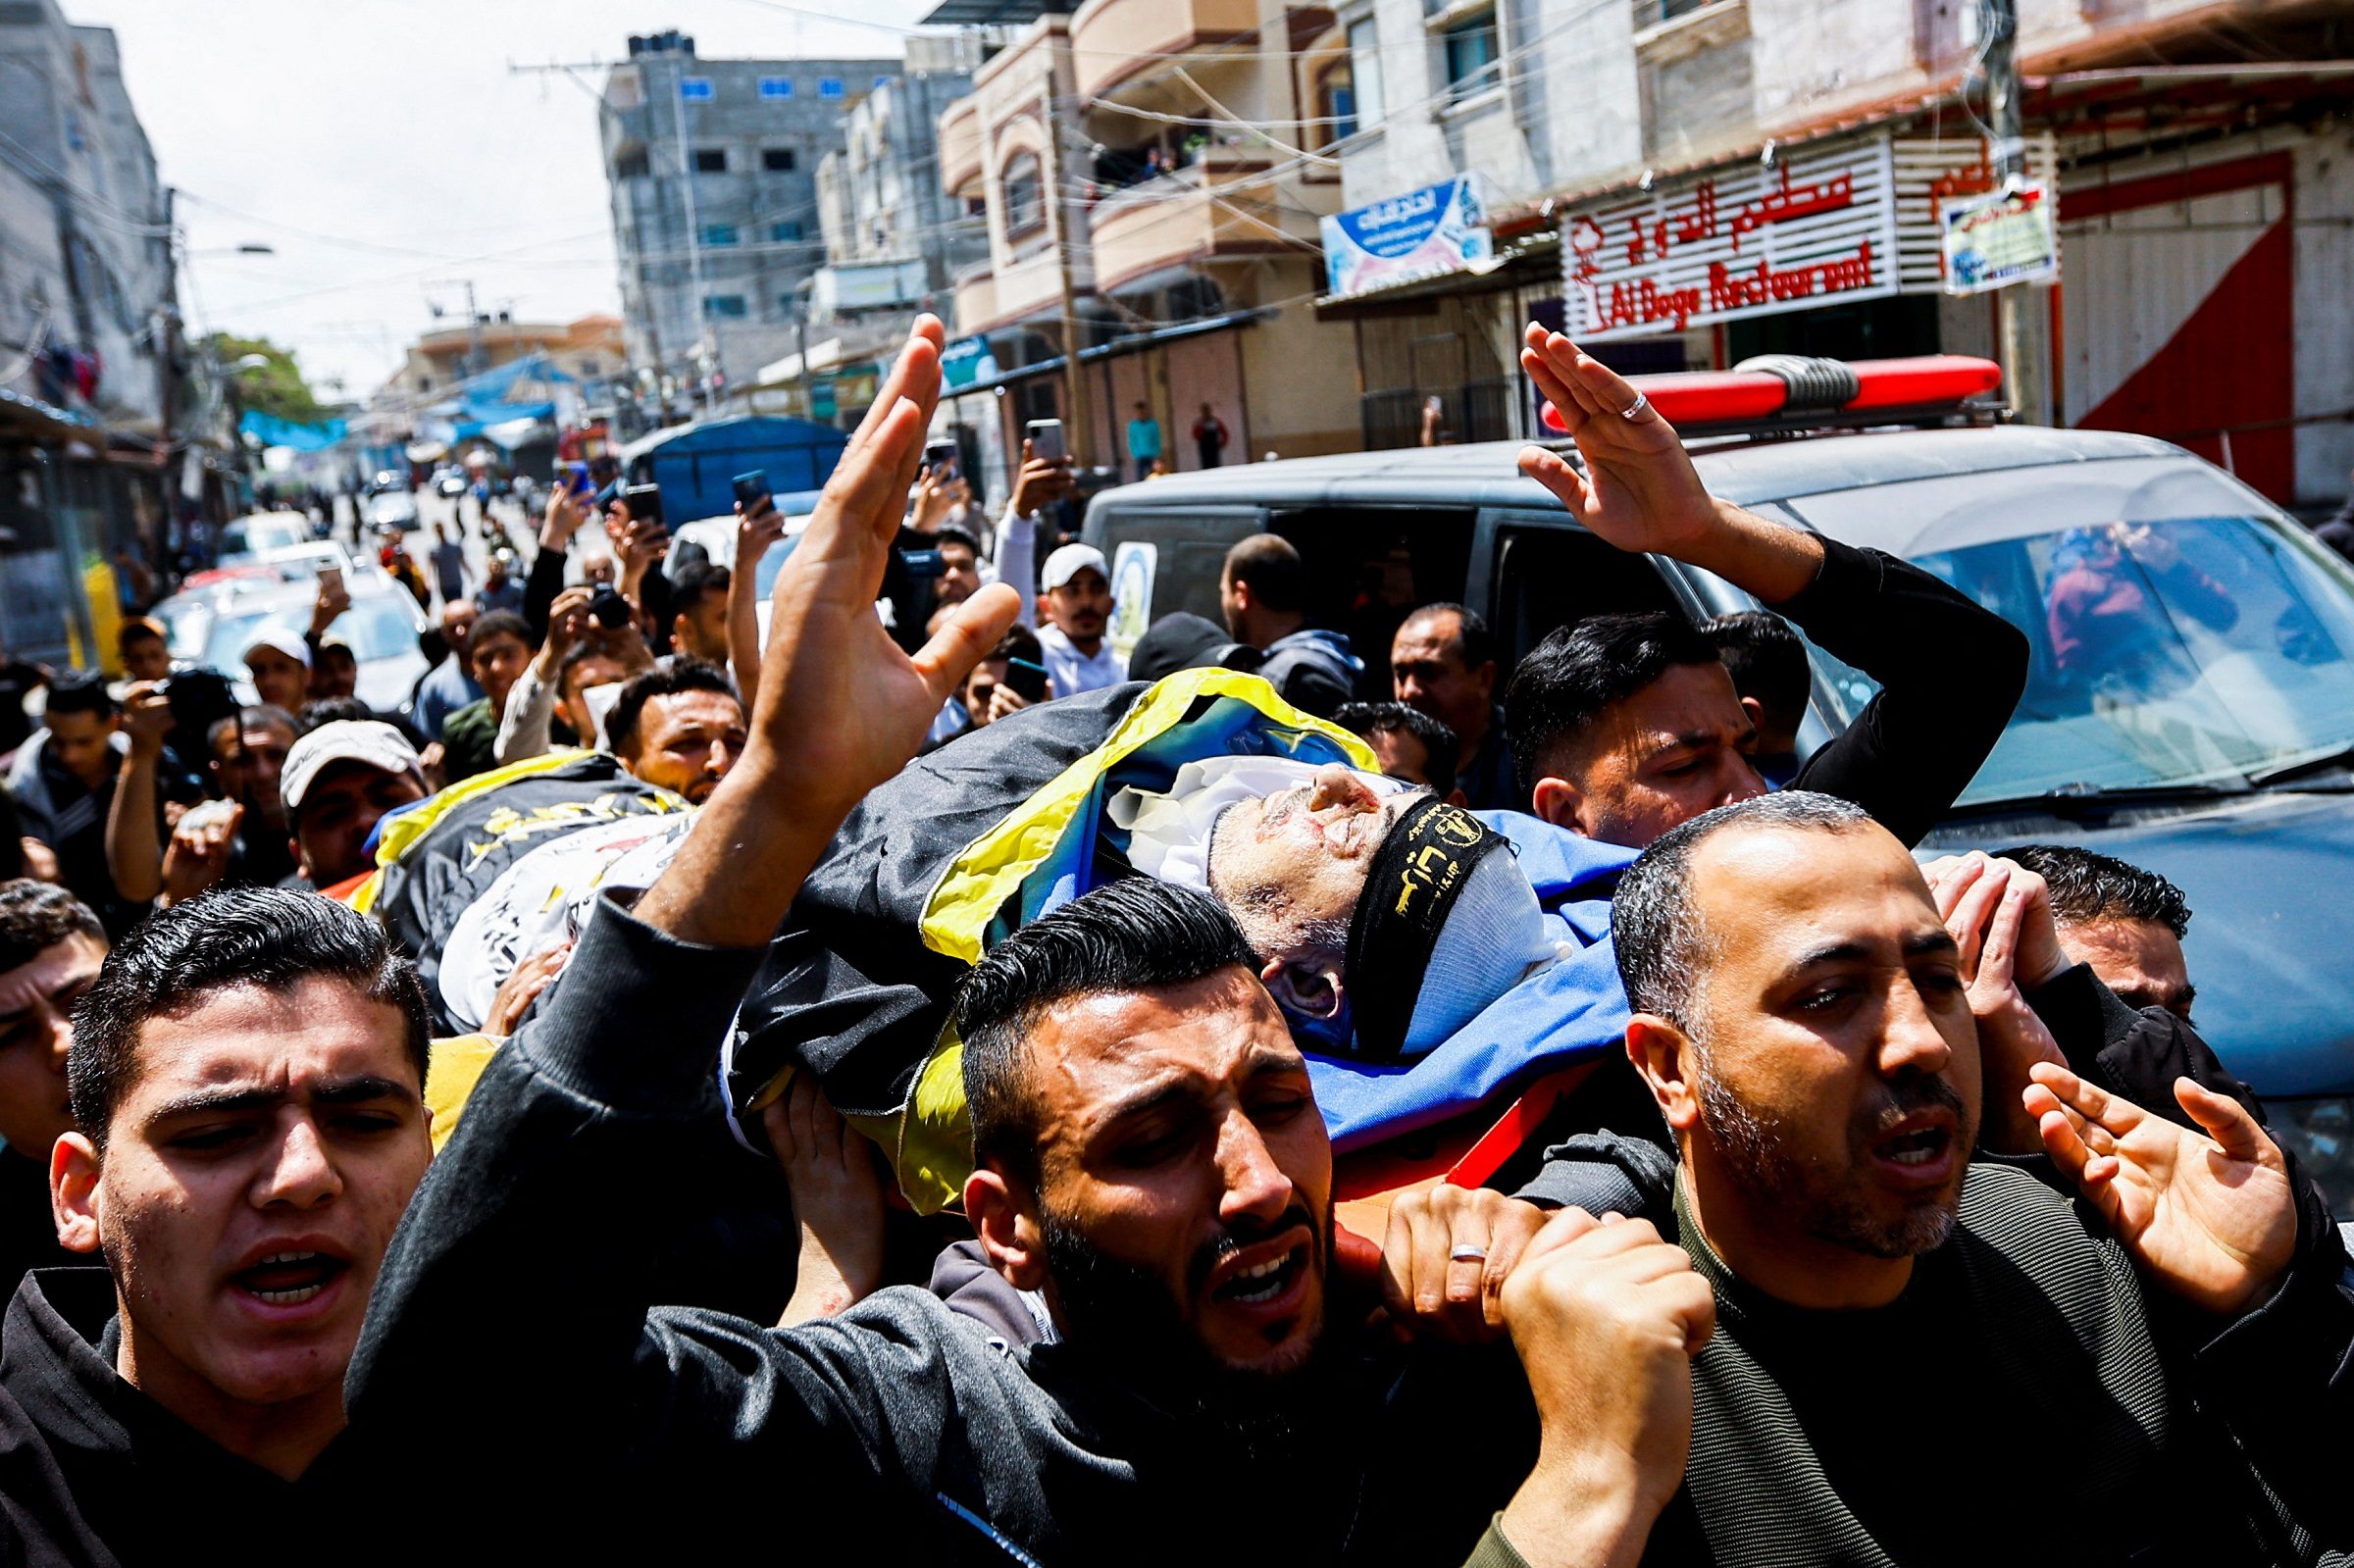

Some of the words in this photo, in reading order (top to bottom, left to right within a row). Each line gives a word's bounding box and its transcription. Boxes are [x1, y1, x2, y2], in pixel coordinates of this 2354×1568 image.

[1730, 159, 1853, 252] مطعم
[1709, 238, 1872, 312] Restaurant
[1395, 845, 1448, 918] سرايا
[1446, 860, 1462, 880] الله
